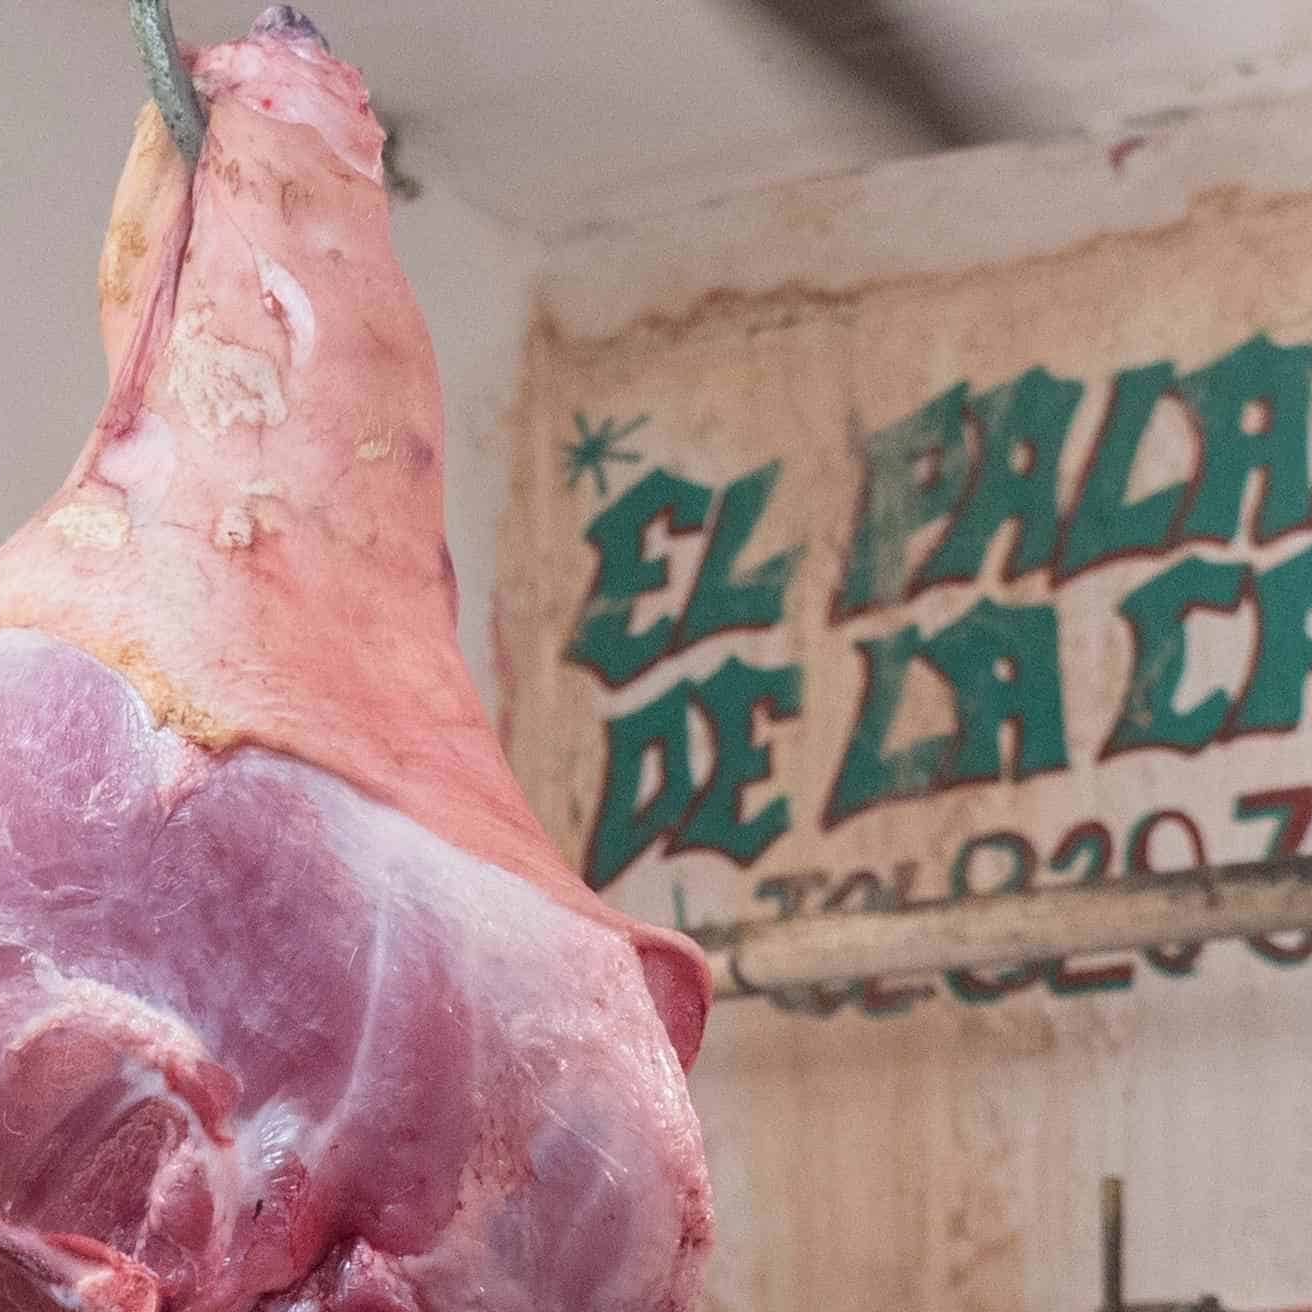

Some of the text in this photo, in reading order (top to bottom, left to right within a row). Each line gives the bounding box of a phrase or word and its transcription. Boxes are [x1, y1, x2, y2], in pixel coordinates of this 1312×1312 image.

[561, 459, 805, 690] EL
[584, 657, 803, 890] DE
[820, 595, 1071, 831] LA
